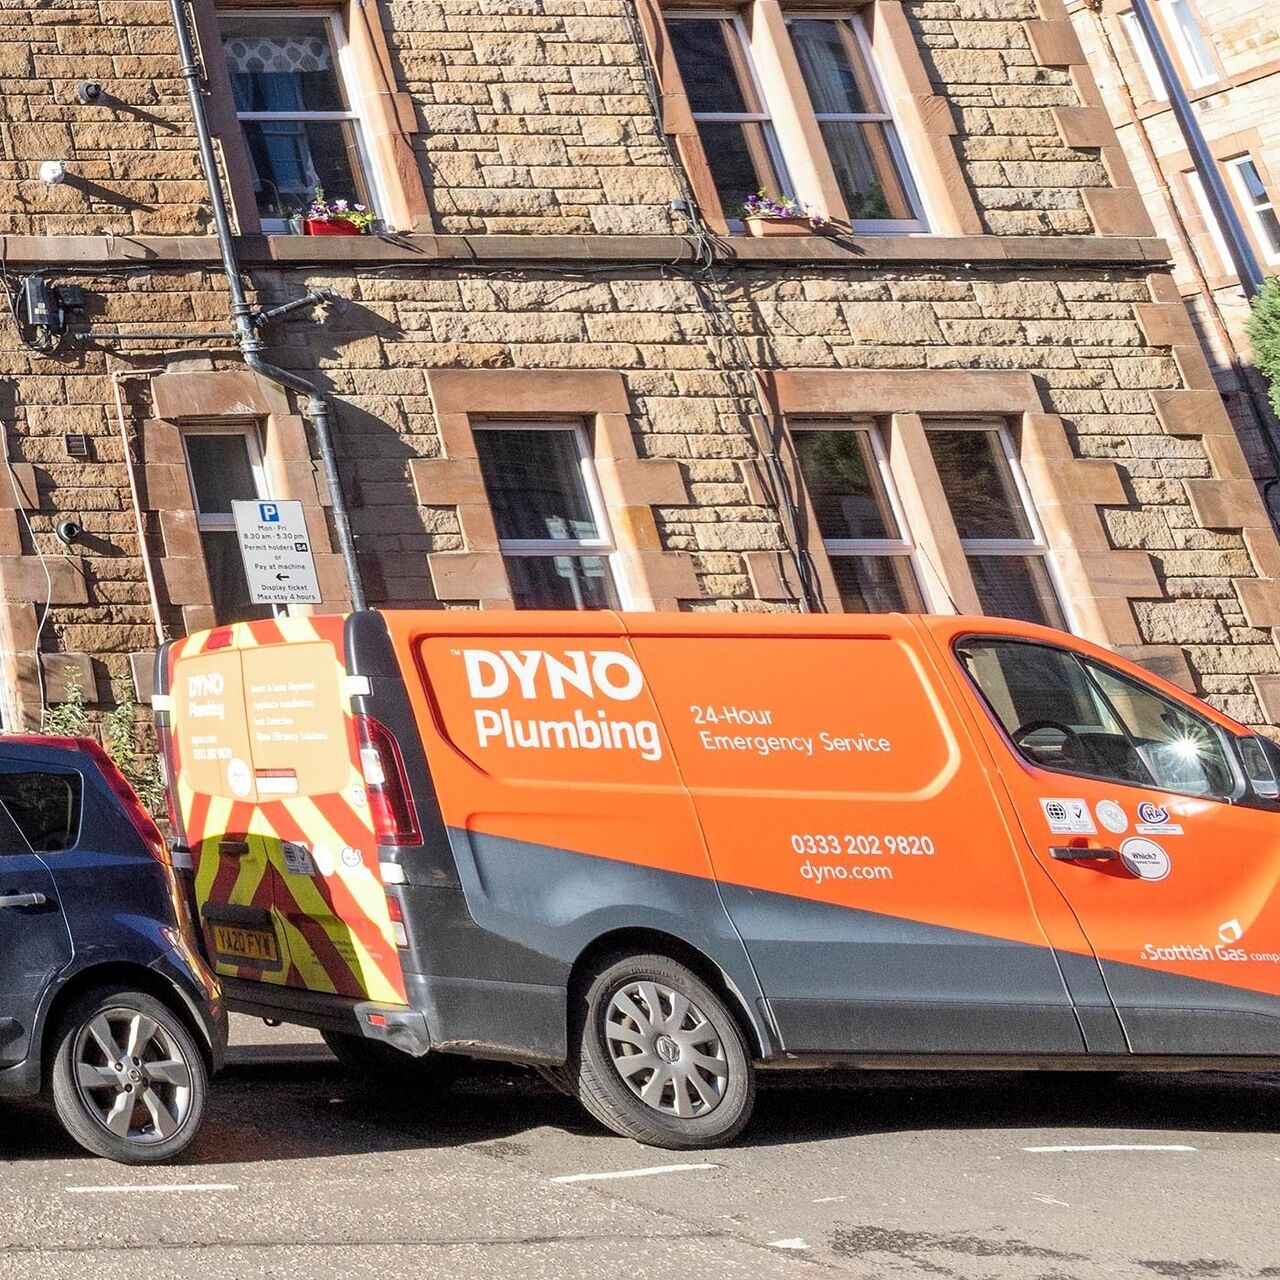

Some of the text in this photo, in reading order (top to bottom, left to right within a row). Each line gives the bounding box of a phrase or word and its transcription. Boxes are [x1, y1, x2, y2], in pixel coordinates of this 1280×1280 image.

[262, 505, 276, 521] P
[243, 532, 260, 540] 8.30
[276, 532, 293, 540] 5.30
[257, 524, 272, 532] Mon
[296, 543, 307, 551] S4
[261, 584, 286, 592] Display
[273, 593, 288, 601] stay
[463, 648, 644, 701] DYNO
[187, 673, 224, 697] DYNO
[690, 705, 773, 725] 24-Hour
[474, 708, 663, 761] Plumbing
[699, 730, 892, 756] Emergency Service
[791, 834, 935, 856] 0333 202 9820
[1131, 852, 1157, 861] Which?
[800, 859, 894, 884] dyno.com
[1140, 943, 1280, 964] a Scottish Gas comp
